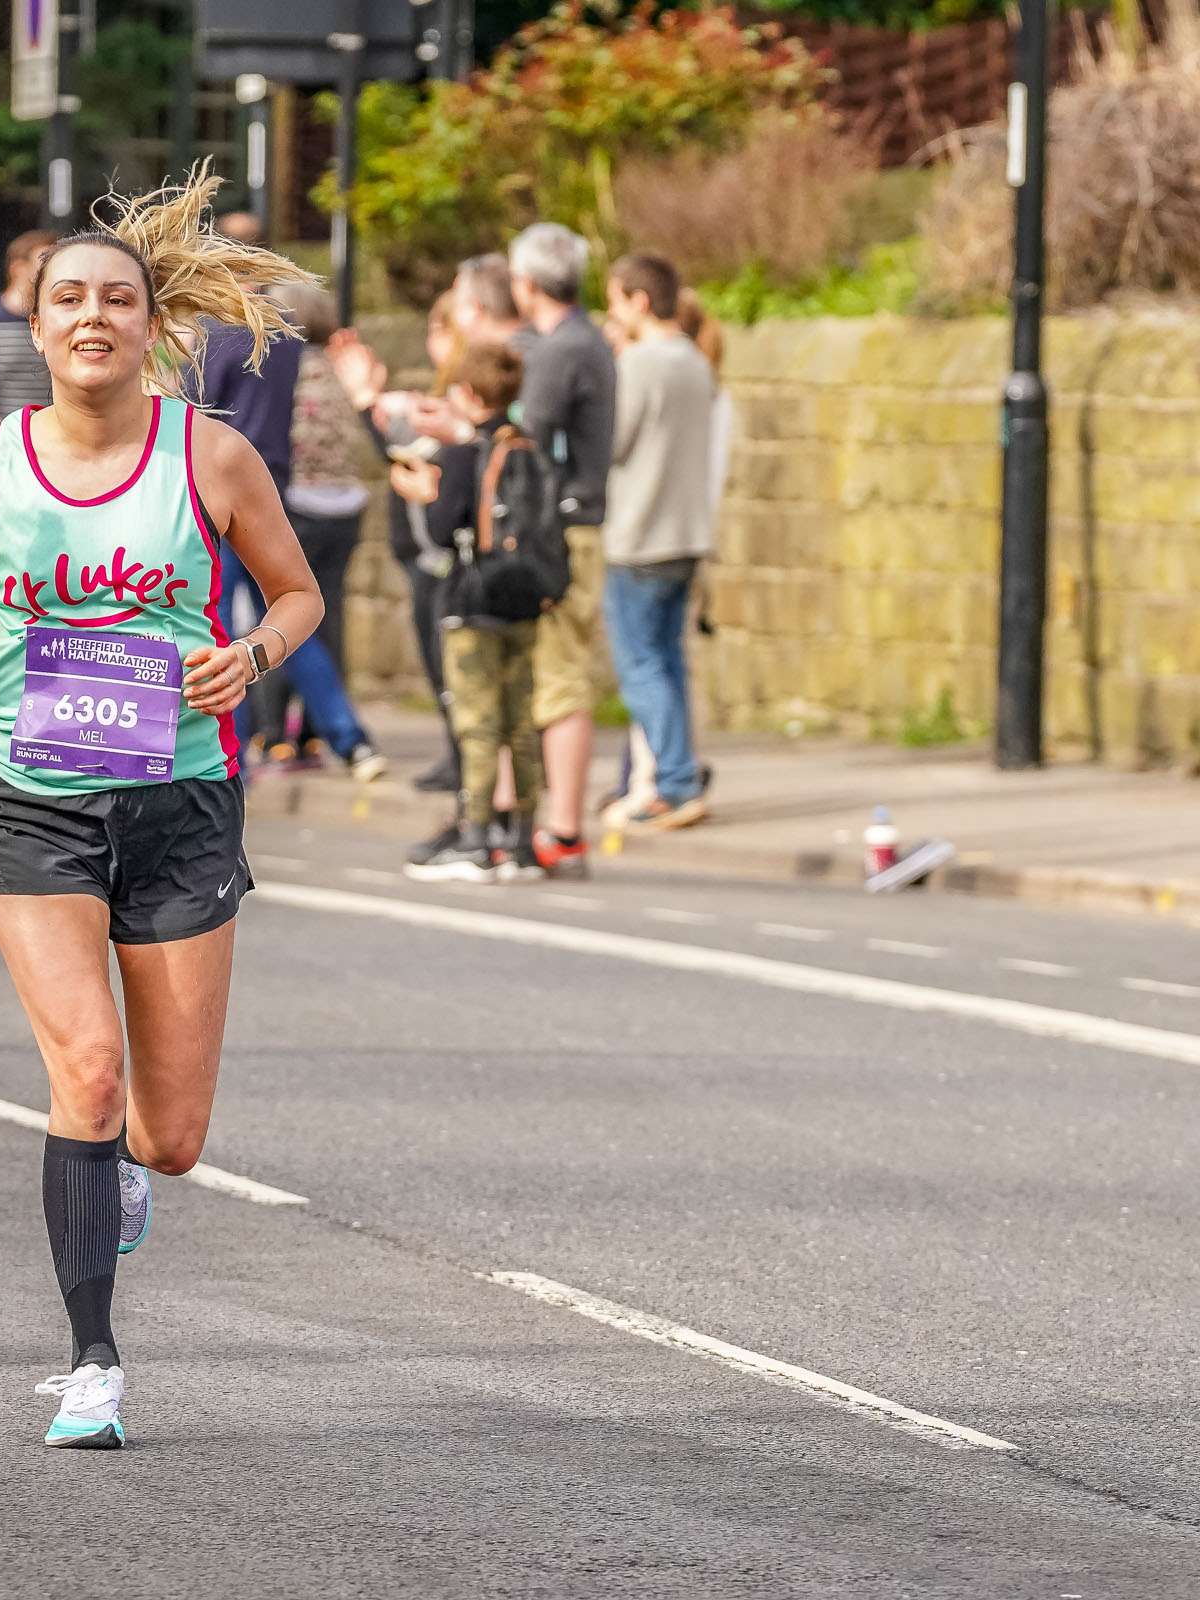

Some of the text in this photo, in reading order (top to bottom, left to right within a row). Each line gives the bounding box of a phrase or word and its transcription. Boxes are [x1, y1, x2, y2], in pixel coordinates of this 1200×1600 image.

[55, 546, 189, 608] Luke's
[68, 638, 124, 653] SHEFFIELD
[68, 650, 167, 671] HALF MARATHON
[134, 669, 166, 683] 2022
[26, 699, 34, 710] S
[54, 694, 139, 729] 6305
[79, 729, 108, 744] MEL
[16, 750, 62, 763] RUN FOR ALL
